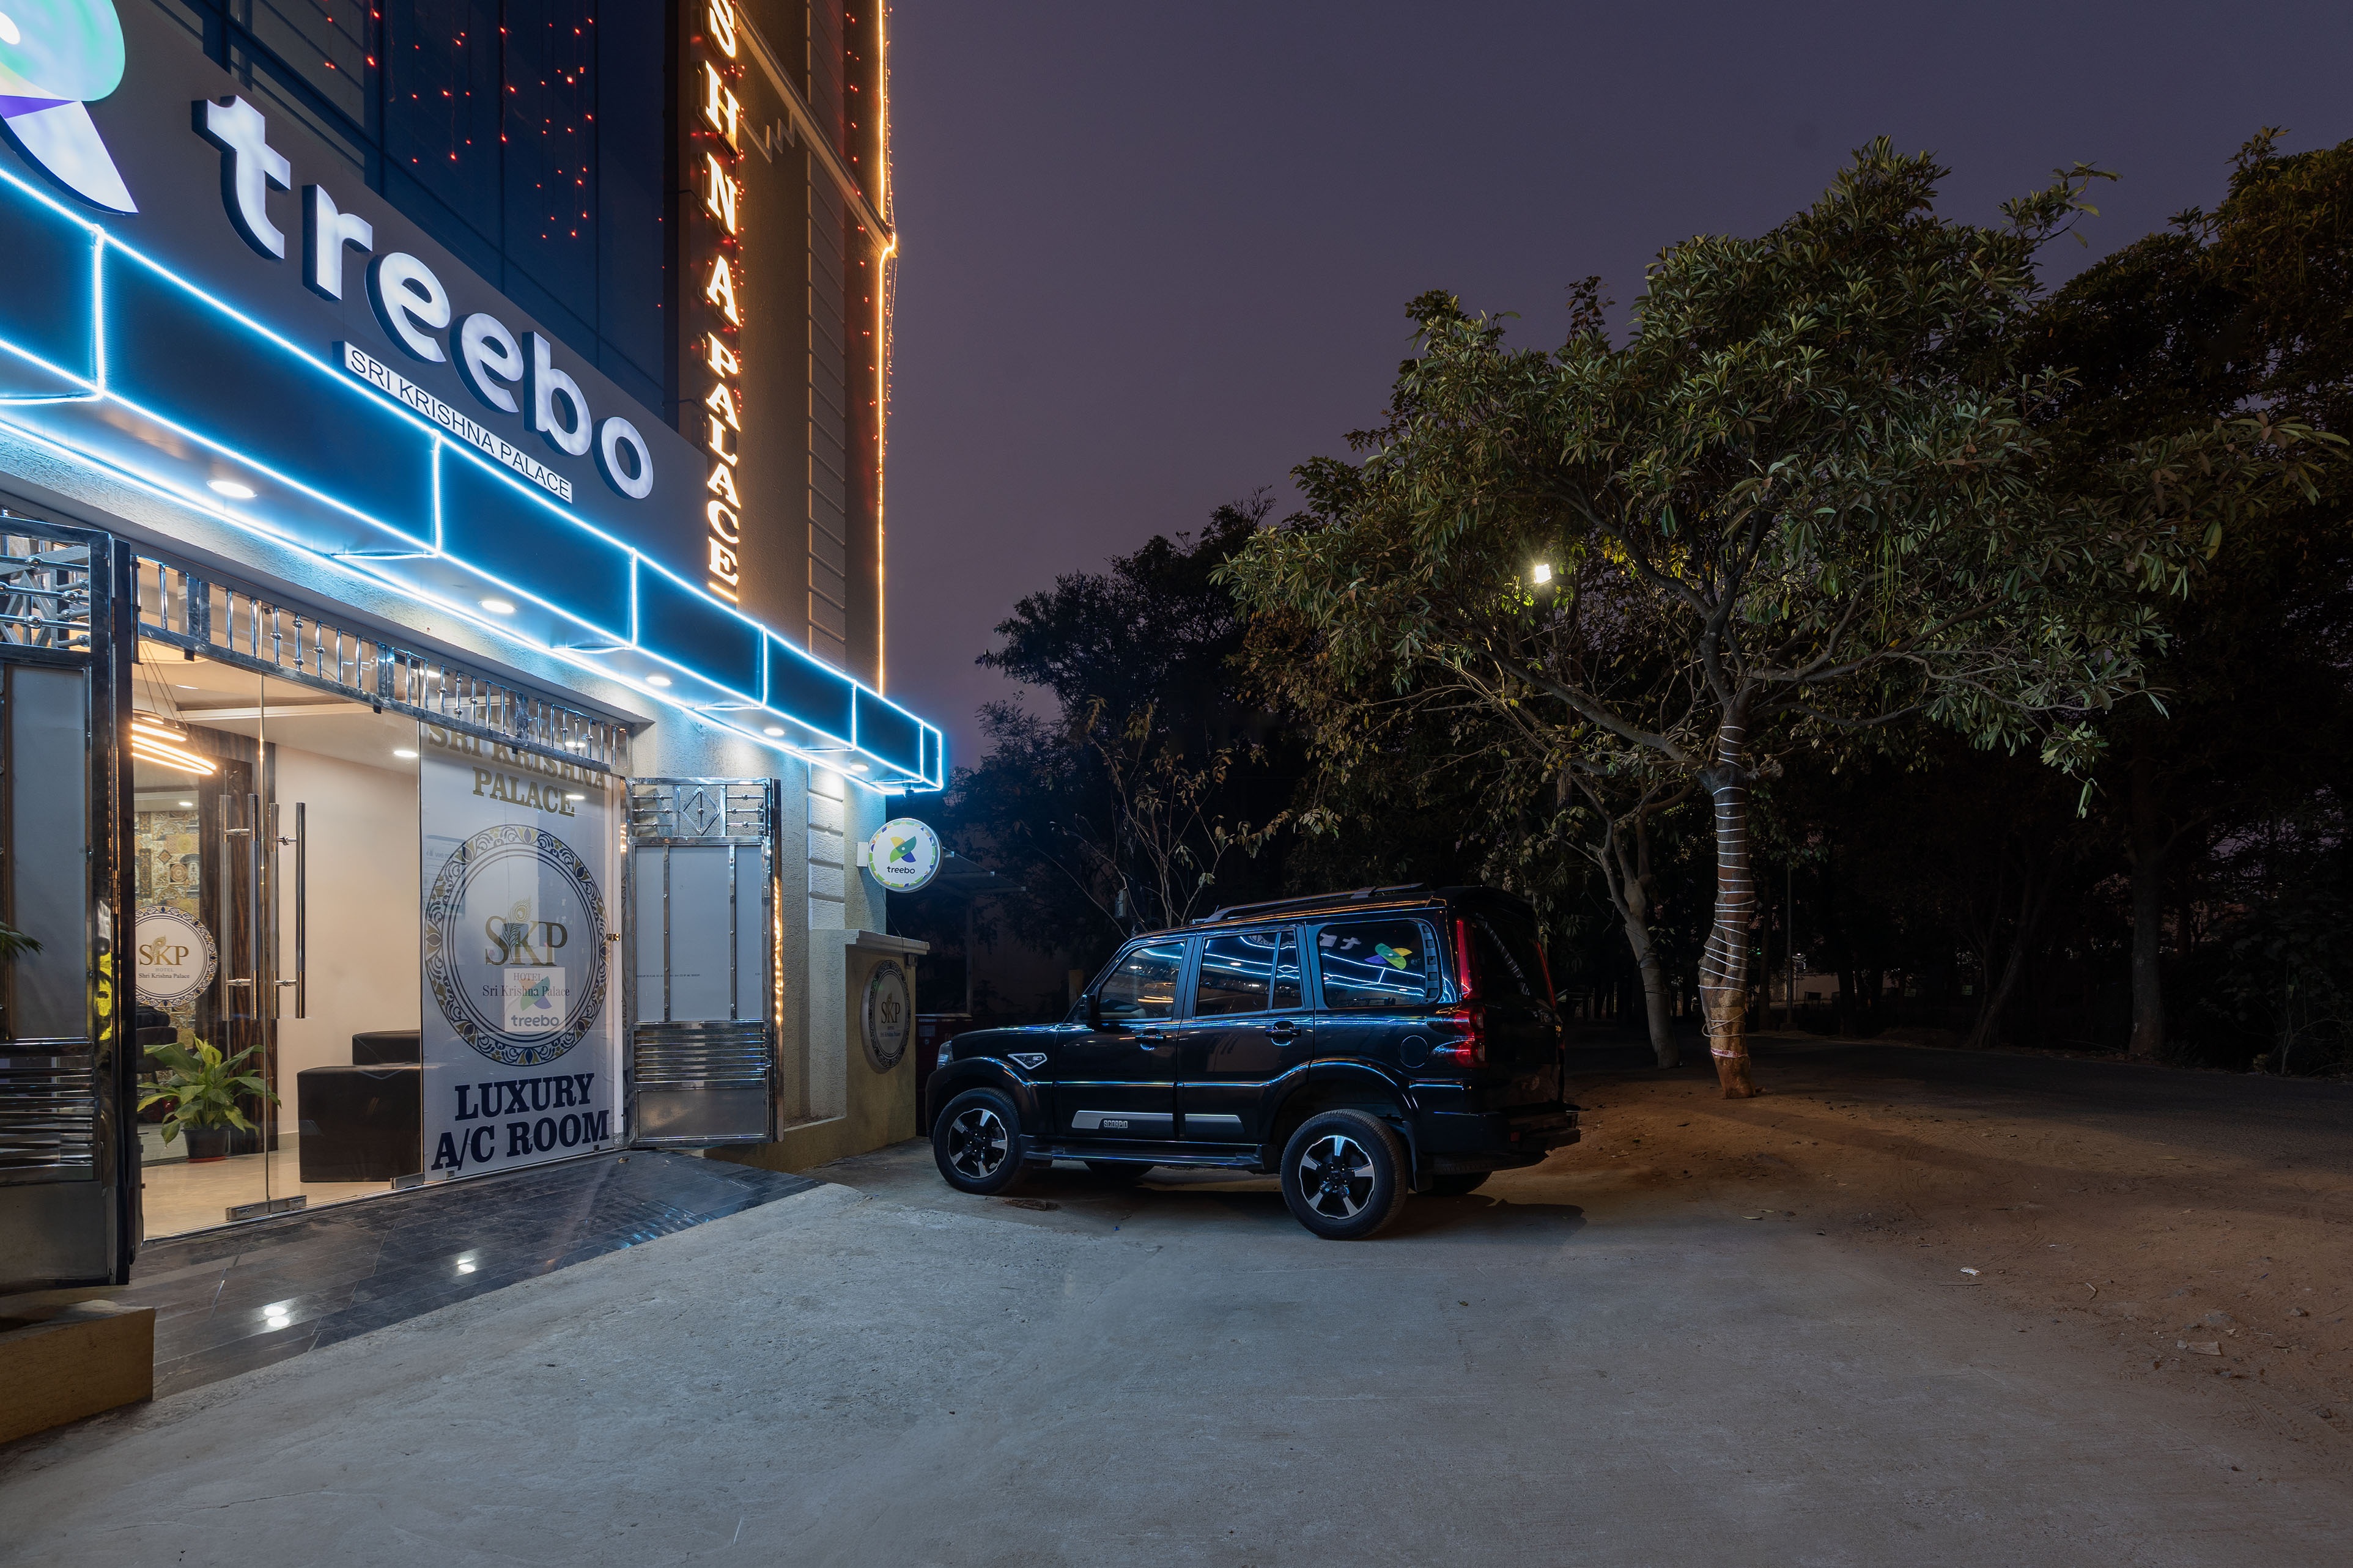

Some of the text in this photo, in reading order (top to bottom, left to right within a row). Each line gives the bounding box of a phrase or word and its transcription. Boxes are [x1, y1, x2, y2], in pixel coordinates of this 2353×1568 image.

[199, 95, 653, 499] treebo
[350, 350, 570, 498] SRI KRISHNA PALACE
[706, 331, 741, 586] PALACE
[472, 766, 575, 817] PALACE
[887, 866, 915, 874] treebo
[139, 944, 189, 966] SKP
[486, 916, 568, 966] SKP
[482, 985, 571, 996] Sri Krishna Palace
[881, 1001, 901, 1023] SKP
[511, 1014, 560, 1027] treebo
[454, 1072, 595, 1121] LUXURY
[430, 1110, 610, 1171] A/C ROOM
[1103, 1120, 1128, 1129] SCORPIO
